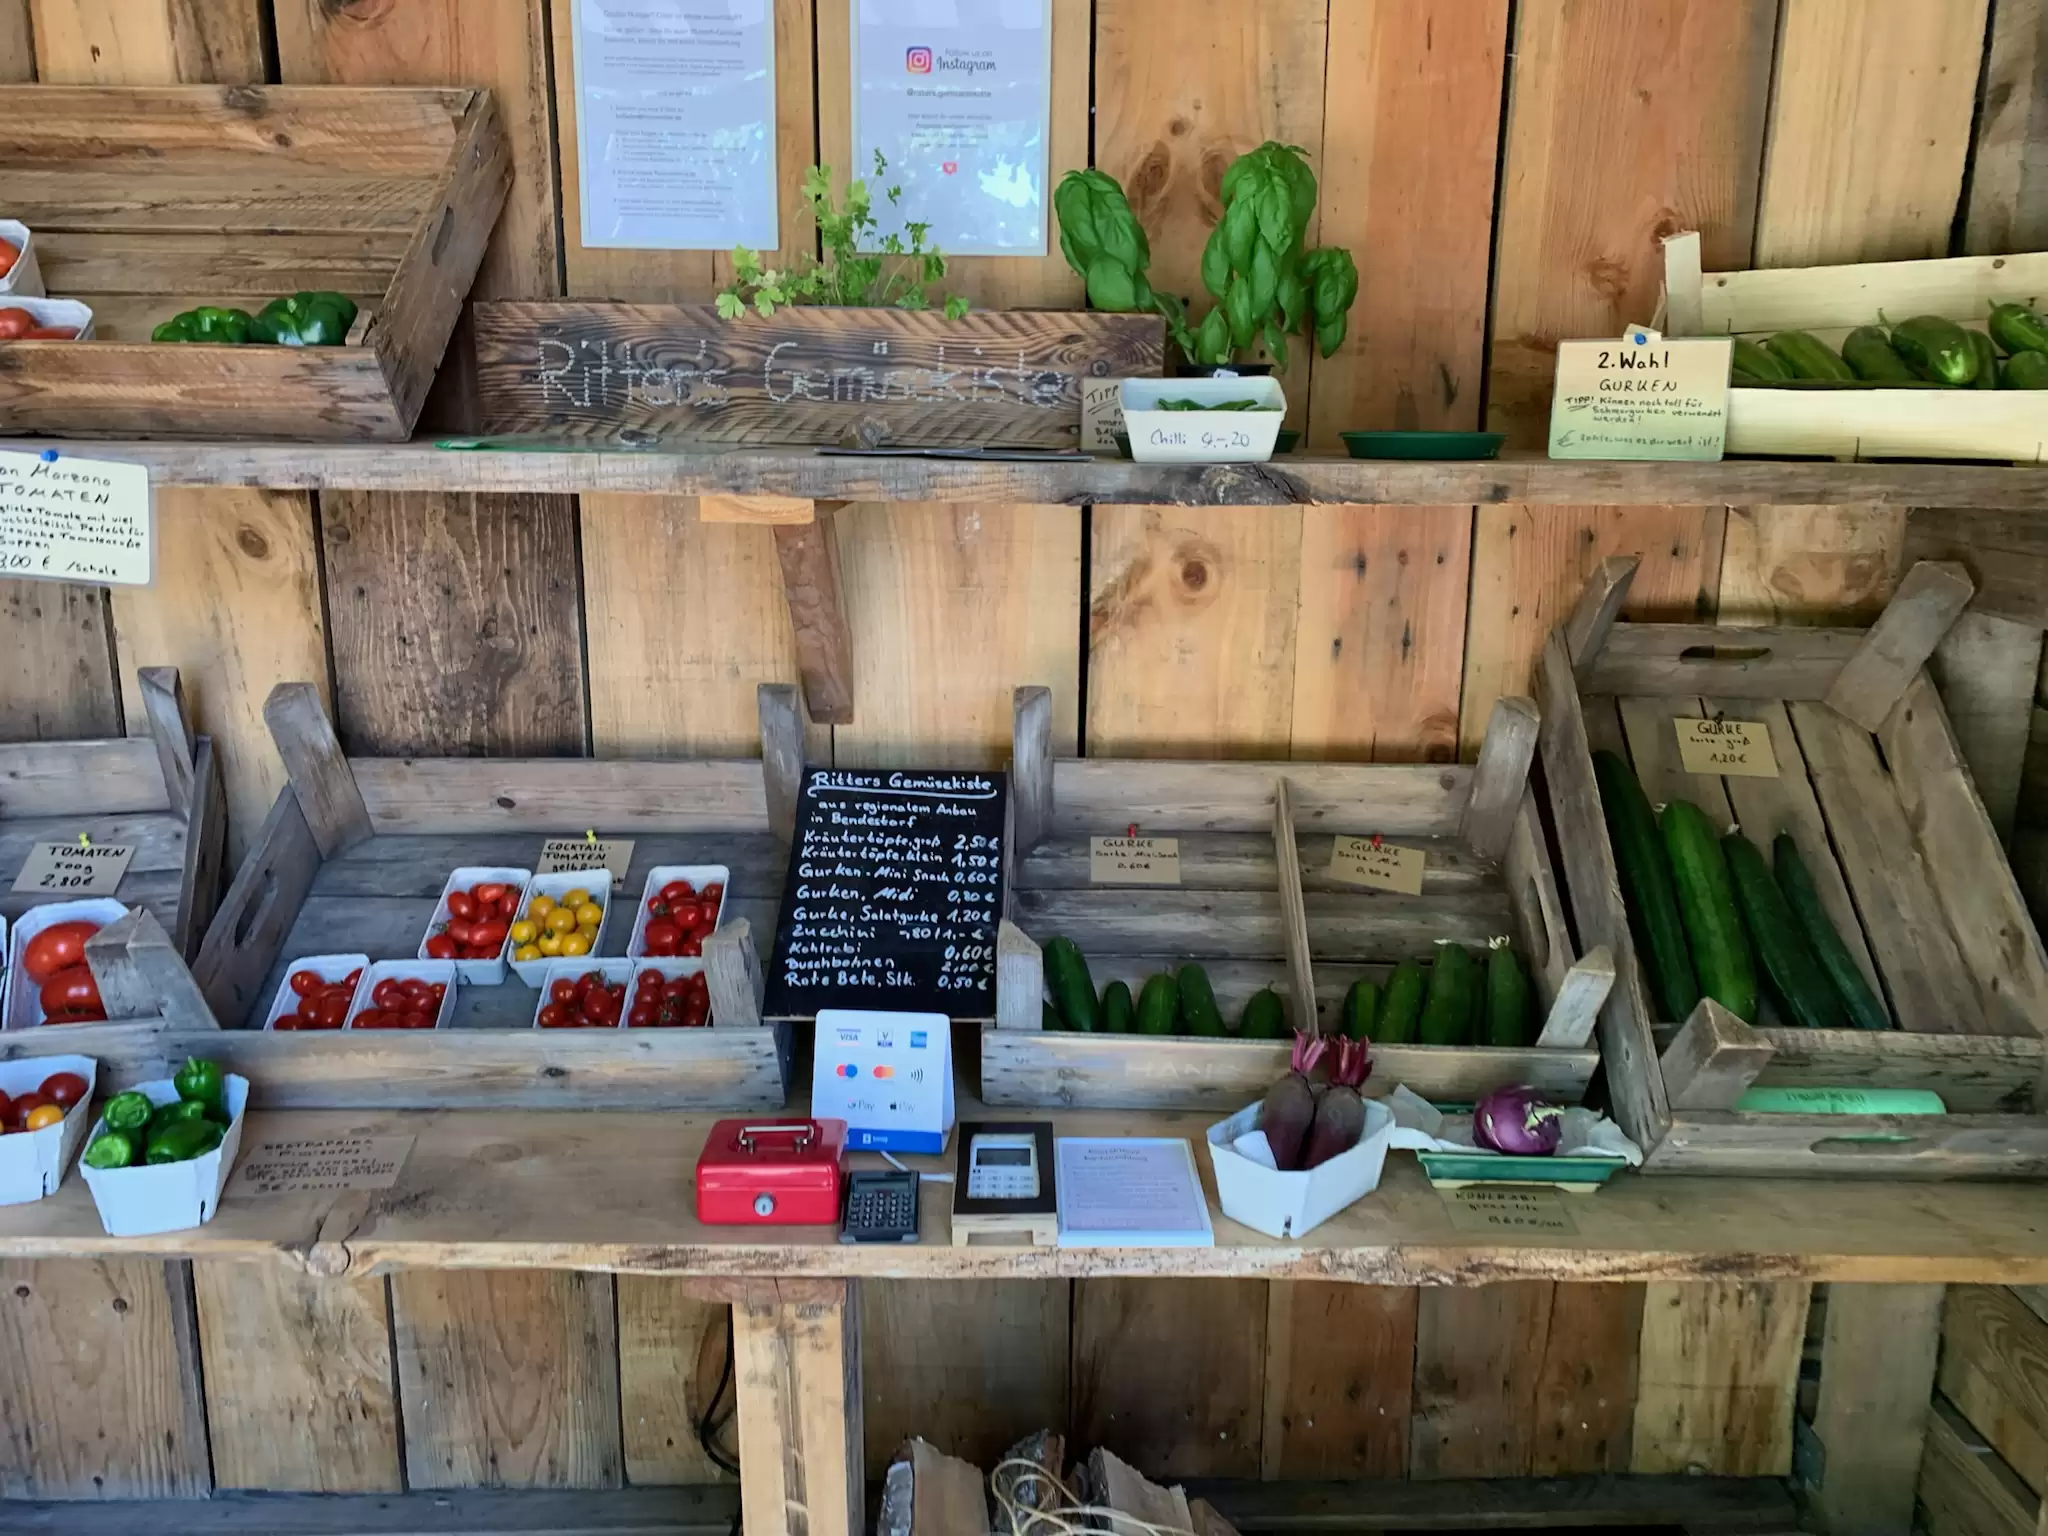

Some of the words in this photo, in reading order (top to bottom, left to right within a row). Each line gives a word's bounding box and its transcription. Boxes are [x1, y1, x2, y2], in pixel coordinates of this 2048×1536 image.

[936, 56, 997, 76] Instagram
[1620, 351, 1669, 369] Wahl
[765, 341, 1073, 409] Gemüsekiste
[1599, 378, 1677, 392] GURKEN
[1564, 396, 1594, 405] TIPP!
[1685, 398, 1703, 407] für
[1671, 408, 1722, 417] verwendet
[1150, 428, 1187, 446] Chilli
[0, 466, 19, 477] an
[30, 463, 111, 487] Marzano
[0, 482, 110, 506] TOMATEN
[36, 506, 81, 521] Tomate
[86, 512, 106, 522] mit
[112, 516, 133, 526] viel
[1697, 721, 1743, 736] GURKE
[811, 771, 881, 787] Ritters
[888, 772, 992, 790] Gemüsekiste
[818, 801, 847, 810] aus
[855, 801, 931, 816] regionalem
[936, 803, 977, 816] Anbau
[811, 811, 823, 824] in
[831, 812, 917, 829] Bendestorf
[48, 845, 126, 858] TOMATEN
[1102, 839, 1155, 848] GURKE
[1350, 840, 1401, 857] GURKE
[543, 851, 607, 861] TOMATEN
[54, 861, 93, 875] 500g
[798, 862, 861, 878] Gurken
[874, 865, 907, 880] Mini
[913, 869, 950, 884] Snack
[796, 883, 866, 902] Gurken,
[873, 886, 919, 901] Midi
[793, 906, 855, 923] Gurke,
[860, 904, 939, 926] Salatgurke
[792, 923, 876, 939] Zucchini
[788, 941, 862, 955] Kohlrabi
[785, 955, 895, 970] Buschbohnen
[784, 969, 831, 988] Rote
[837, 969, 882, 988] Bete,
[886, 970, 916, 987] Stk.
[840, 1032, 859, 1041] VISA
